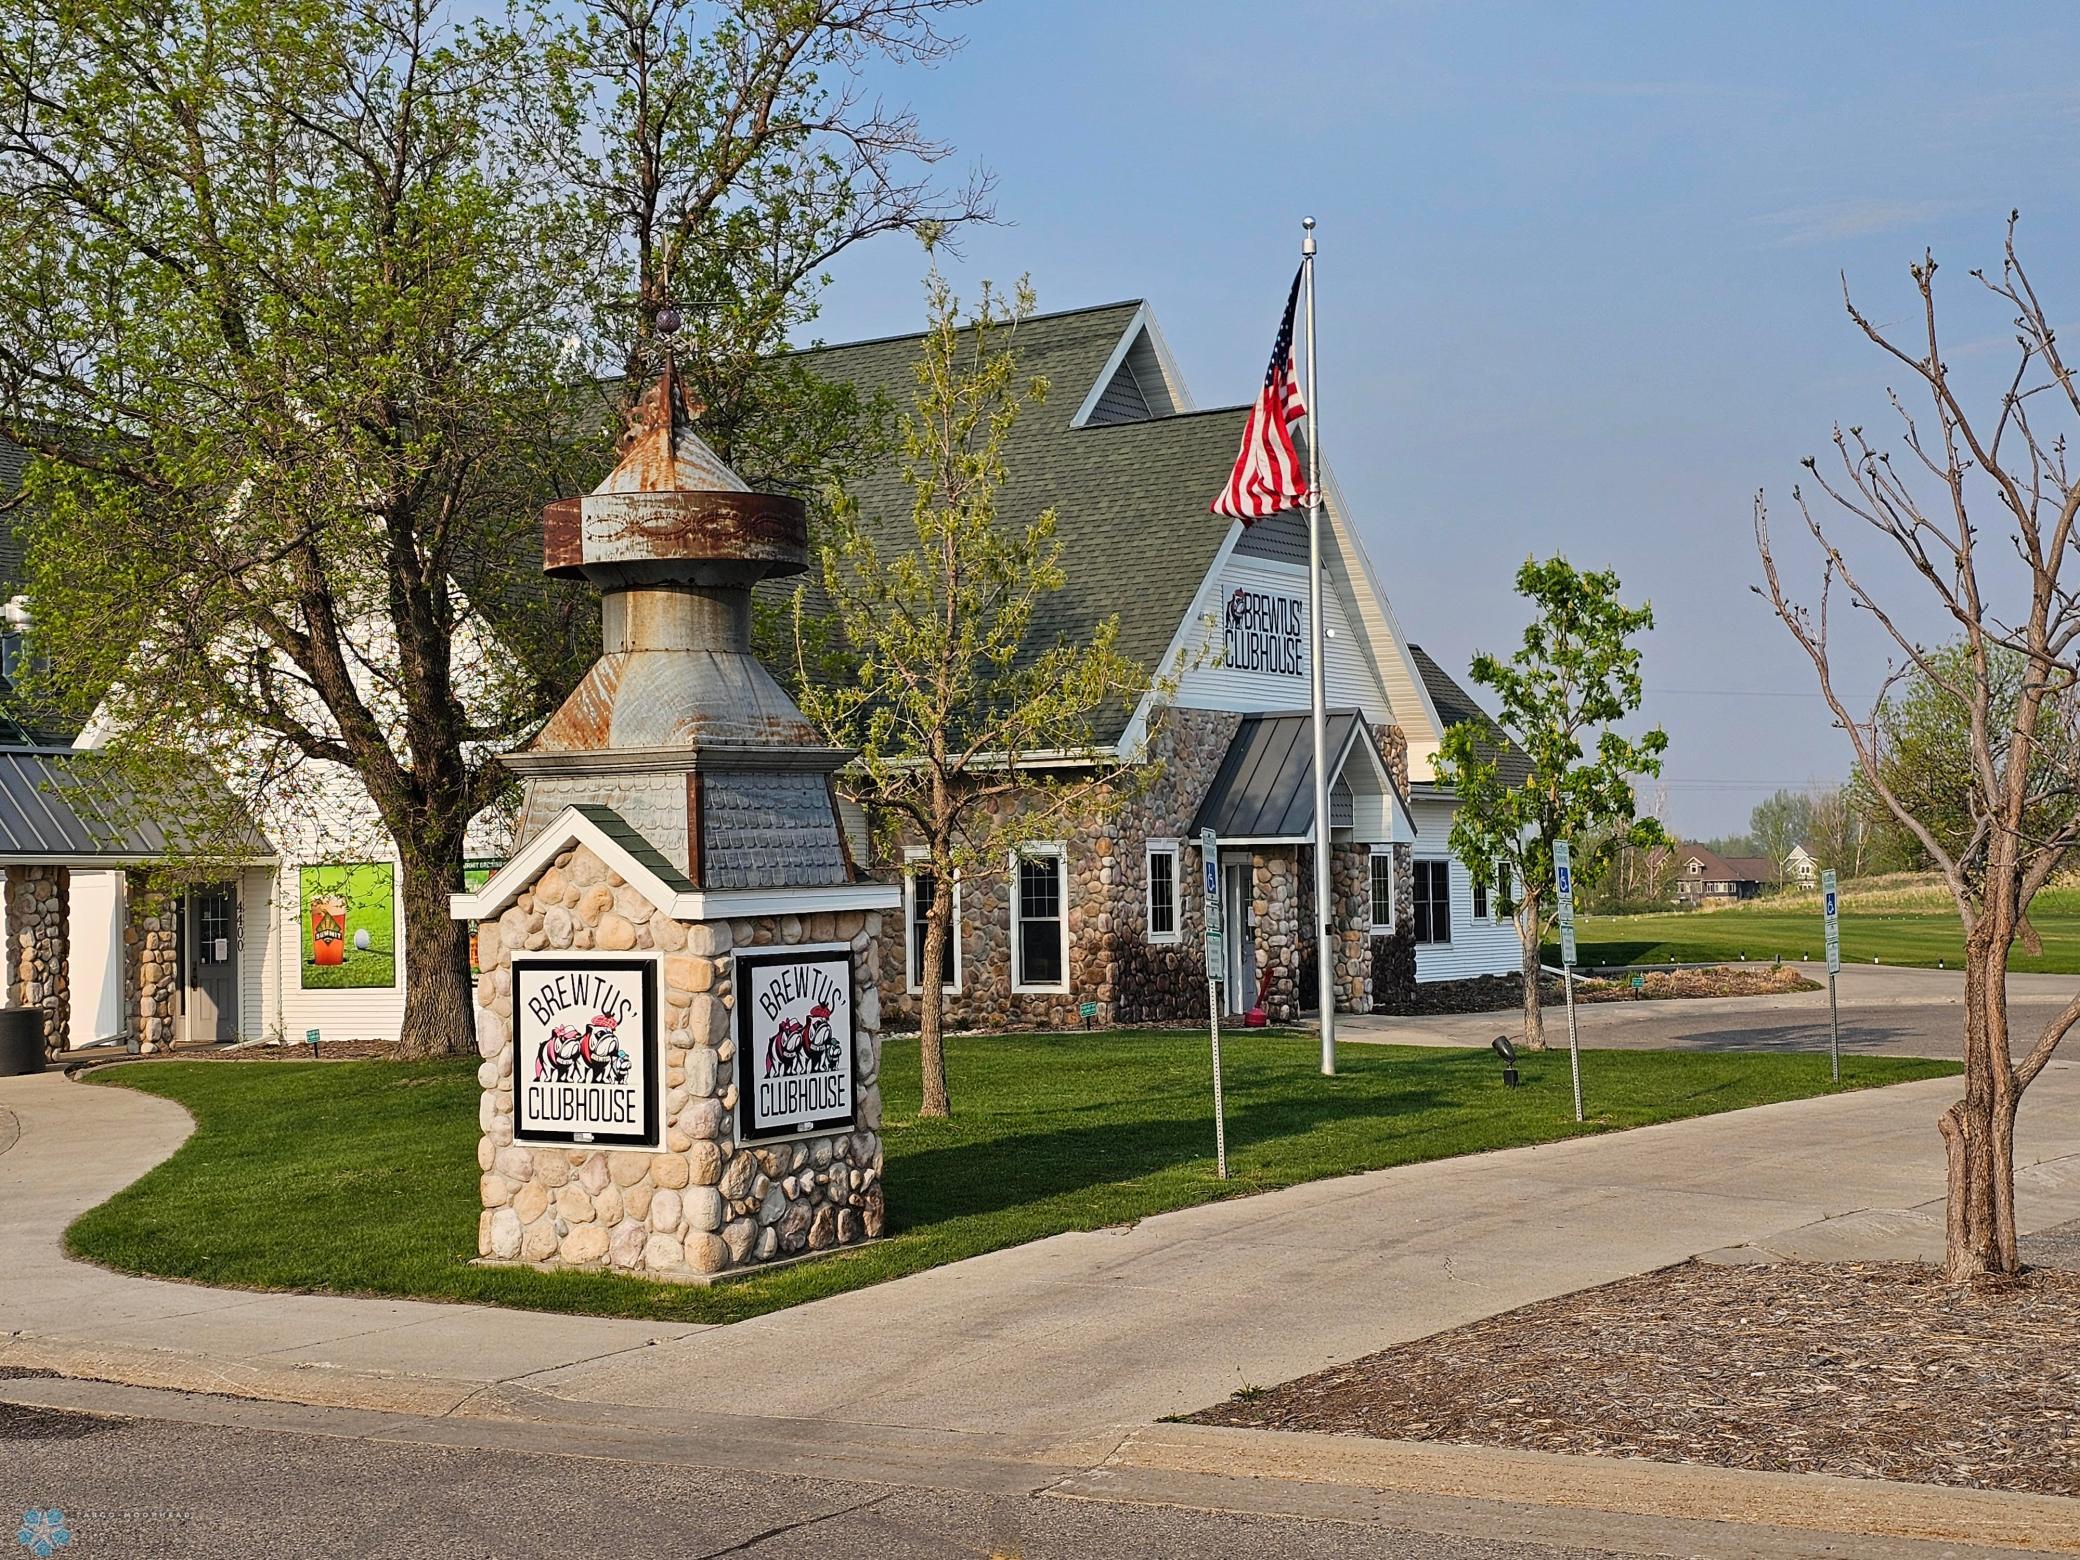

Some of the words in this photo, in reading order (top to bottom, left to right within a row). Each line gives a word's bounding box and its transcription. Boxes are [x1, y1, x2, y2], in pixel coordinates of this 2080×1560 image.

[1244, 592, 1303, 637] BREWTUS'
[1225, 629, 1303, 676] CLUBHOUSE
[315, 930, 342, 940] SUMMIT
[528, 973, 638, 1026] BREWTUS'
[759, 965, 846, 1022] BREWTUS'
[528, 1086, 636, 1123] CLUBHOUSE
[760, 1074, 846, 1118] CLUBHOUSE
